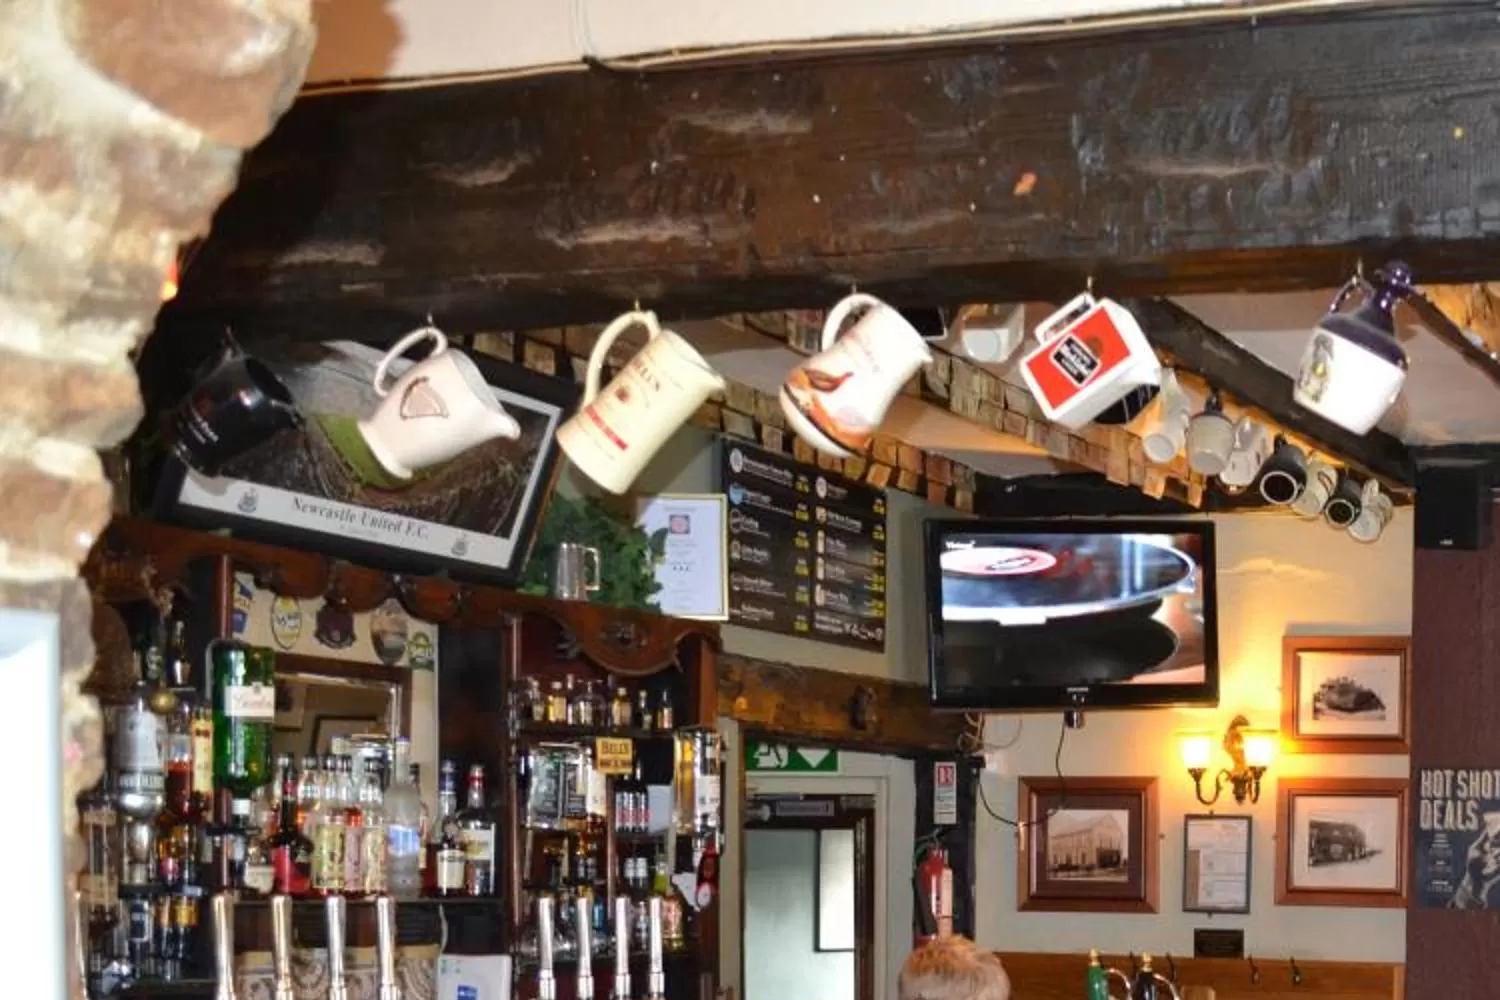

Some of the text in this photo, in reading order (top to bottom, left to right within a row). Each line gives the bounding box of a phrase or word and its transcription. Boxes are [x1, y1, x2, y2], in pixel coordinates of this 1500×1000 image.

[293, 496, 357, 524] Newcastle
[359, 513, 403, 535] United
[1420, 769, 1455, 799] HOT
[1419, 799, 1480, 831] DEALS
